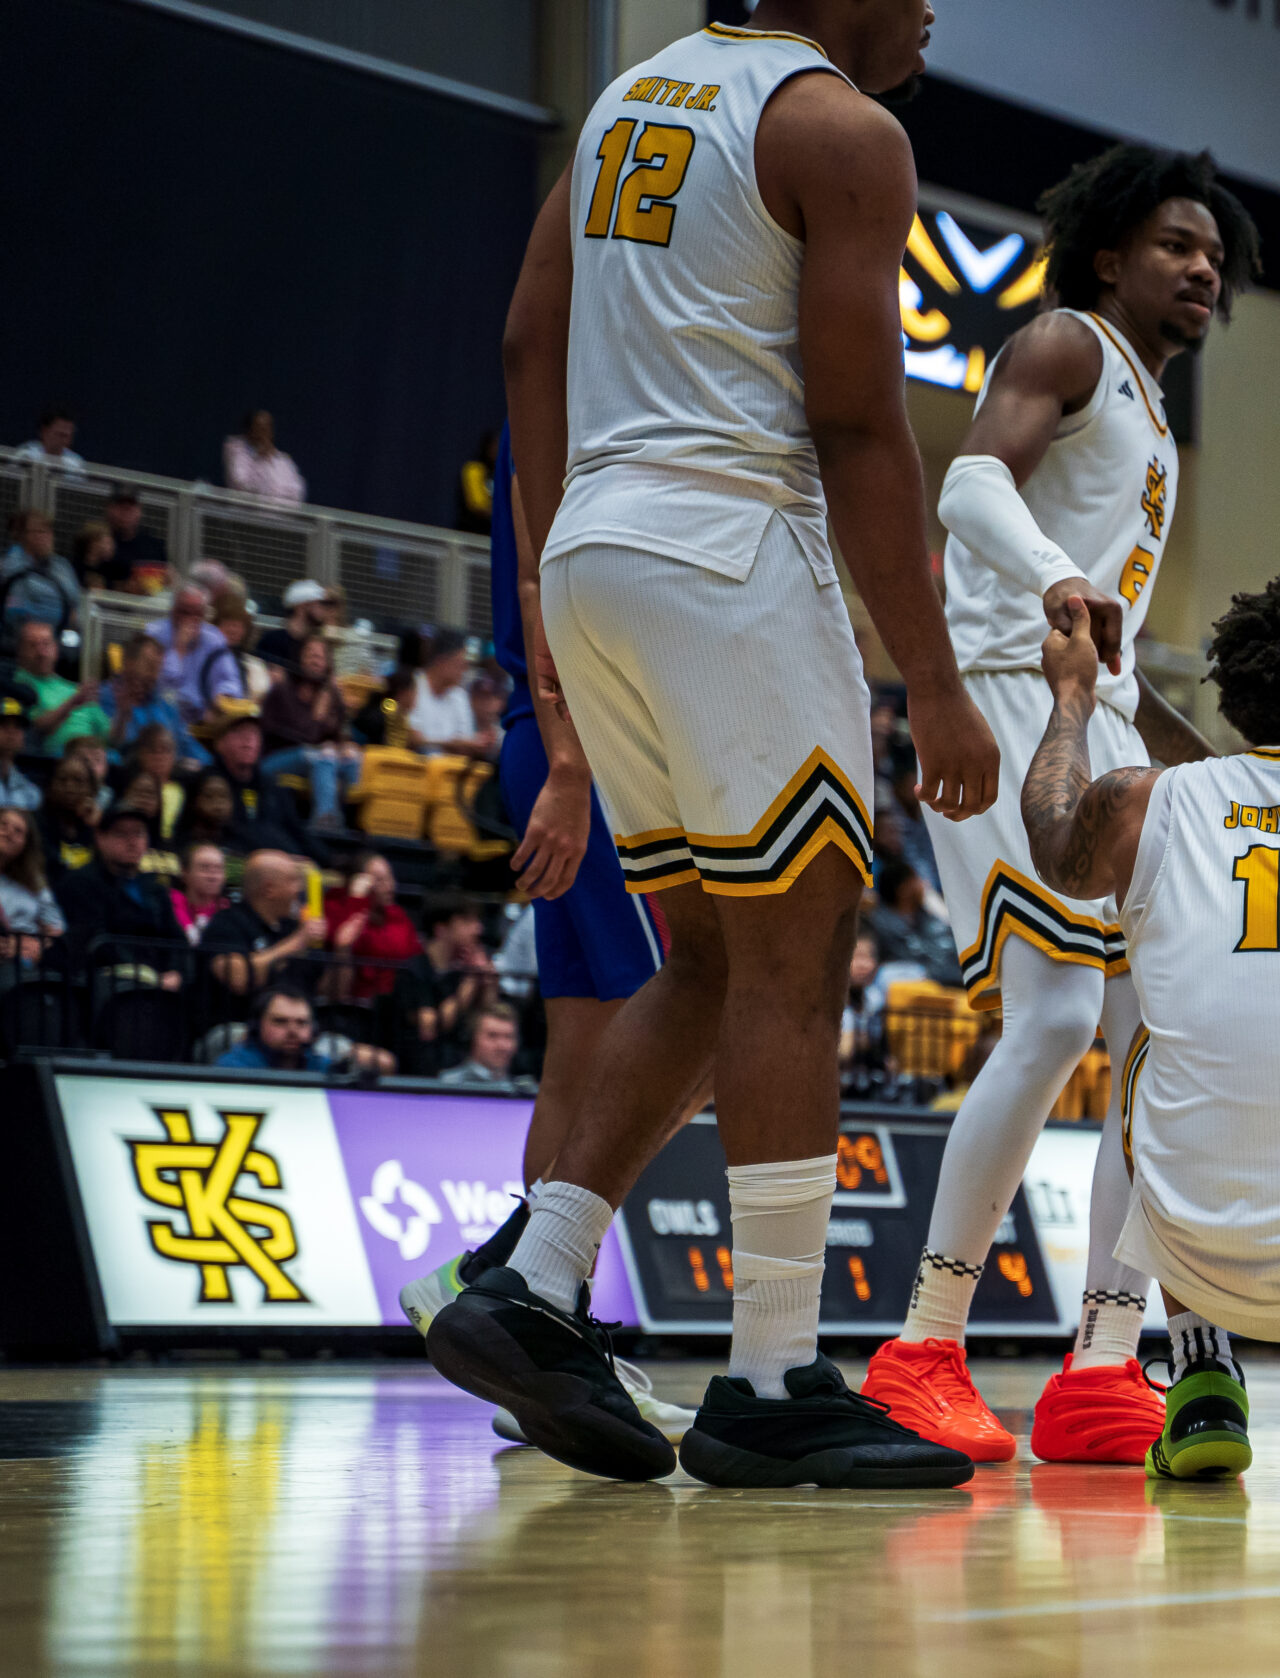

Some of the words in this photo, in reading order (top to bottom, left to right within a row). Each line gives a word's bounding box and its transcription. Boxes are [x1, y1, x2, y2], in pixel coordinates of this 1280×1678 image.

[623, 76, 695, 108] SMITH
[684, 84, 720, 112] JR.
[584, 117, 695, 248] 12
[848, 1256, 871, 1301] 1
